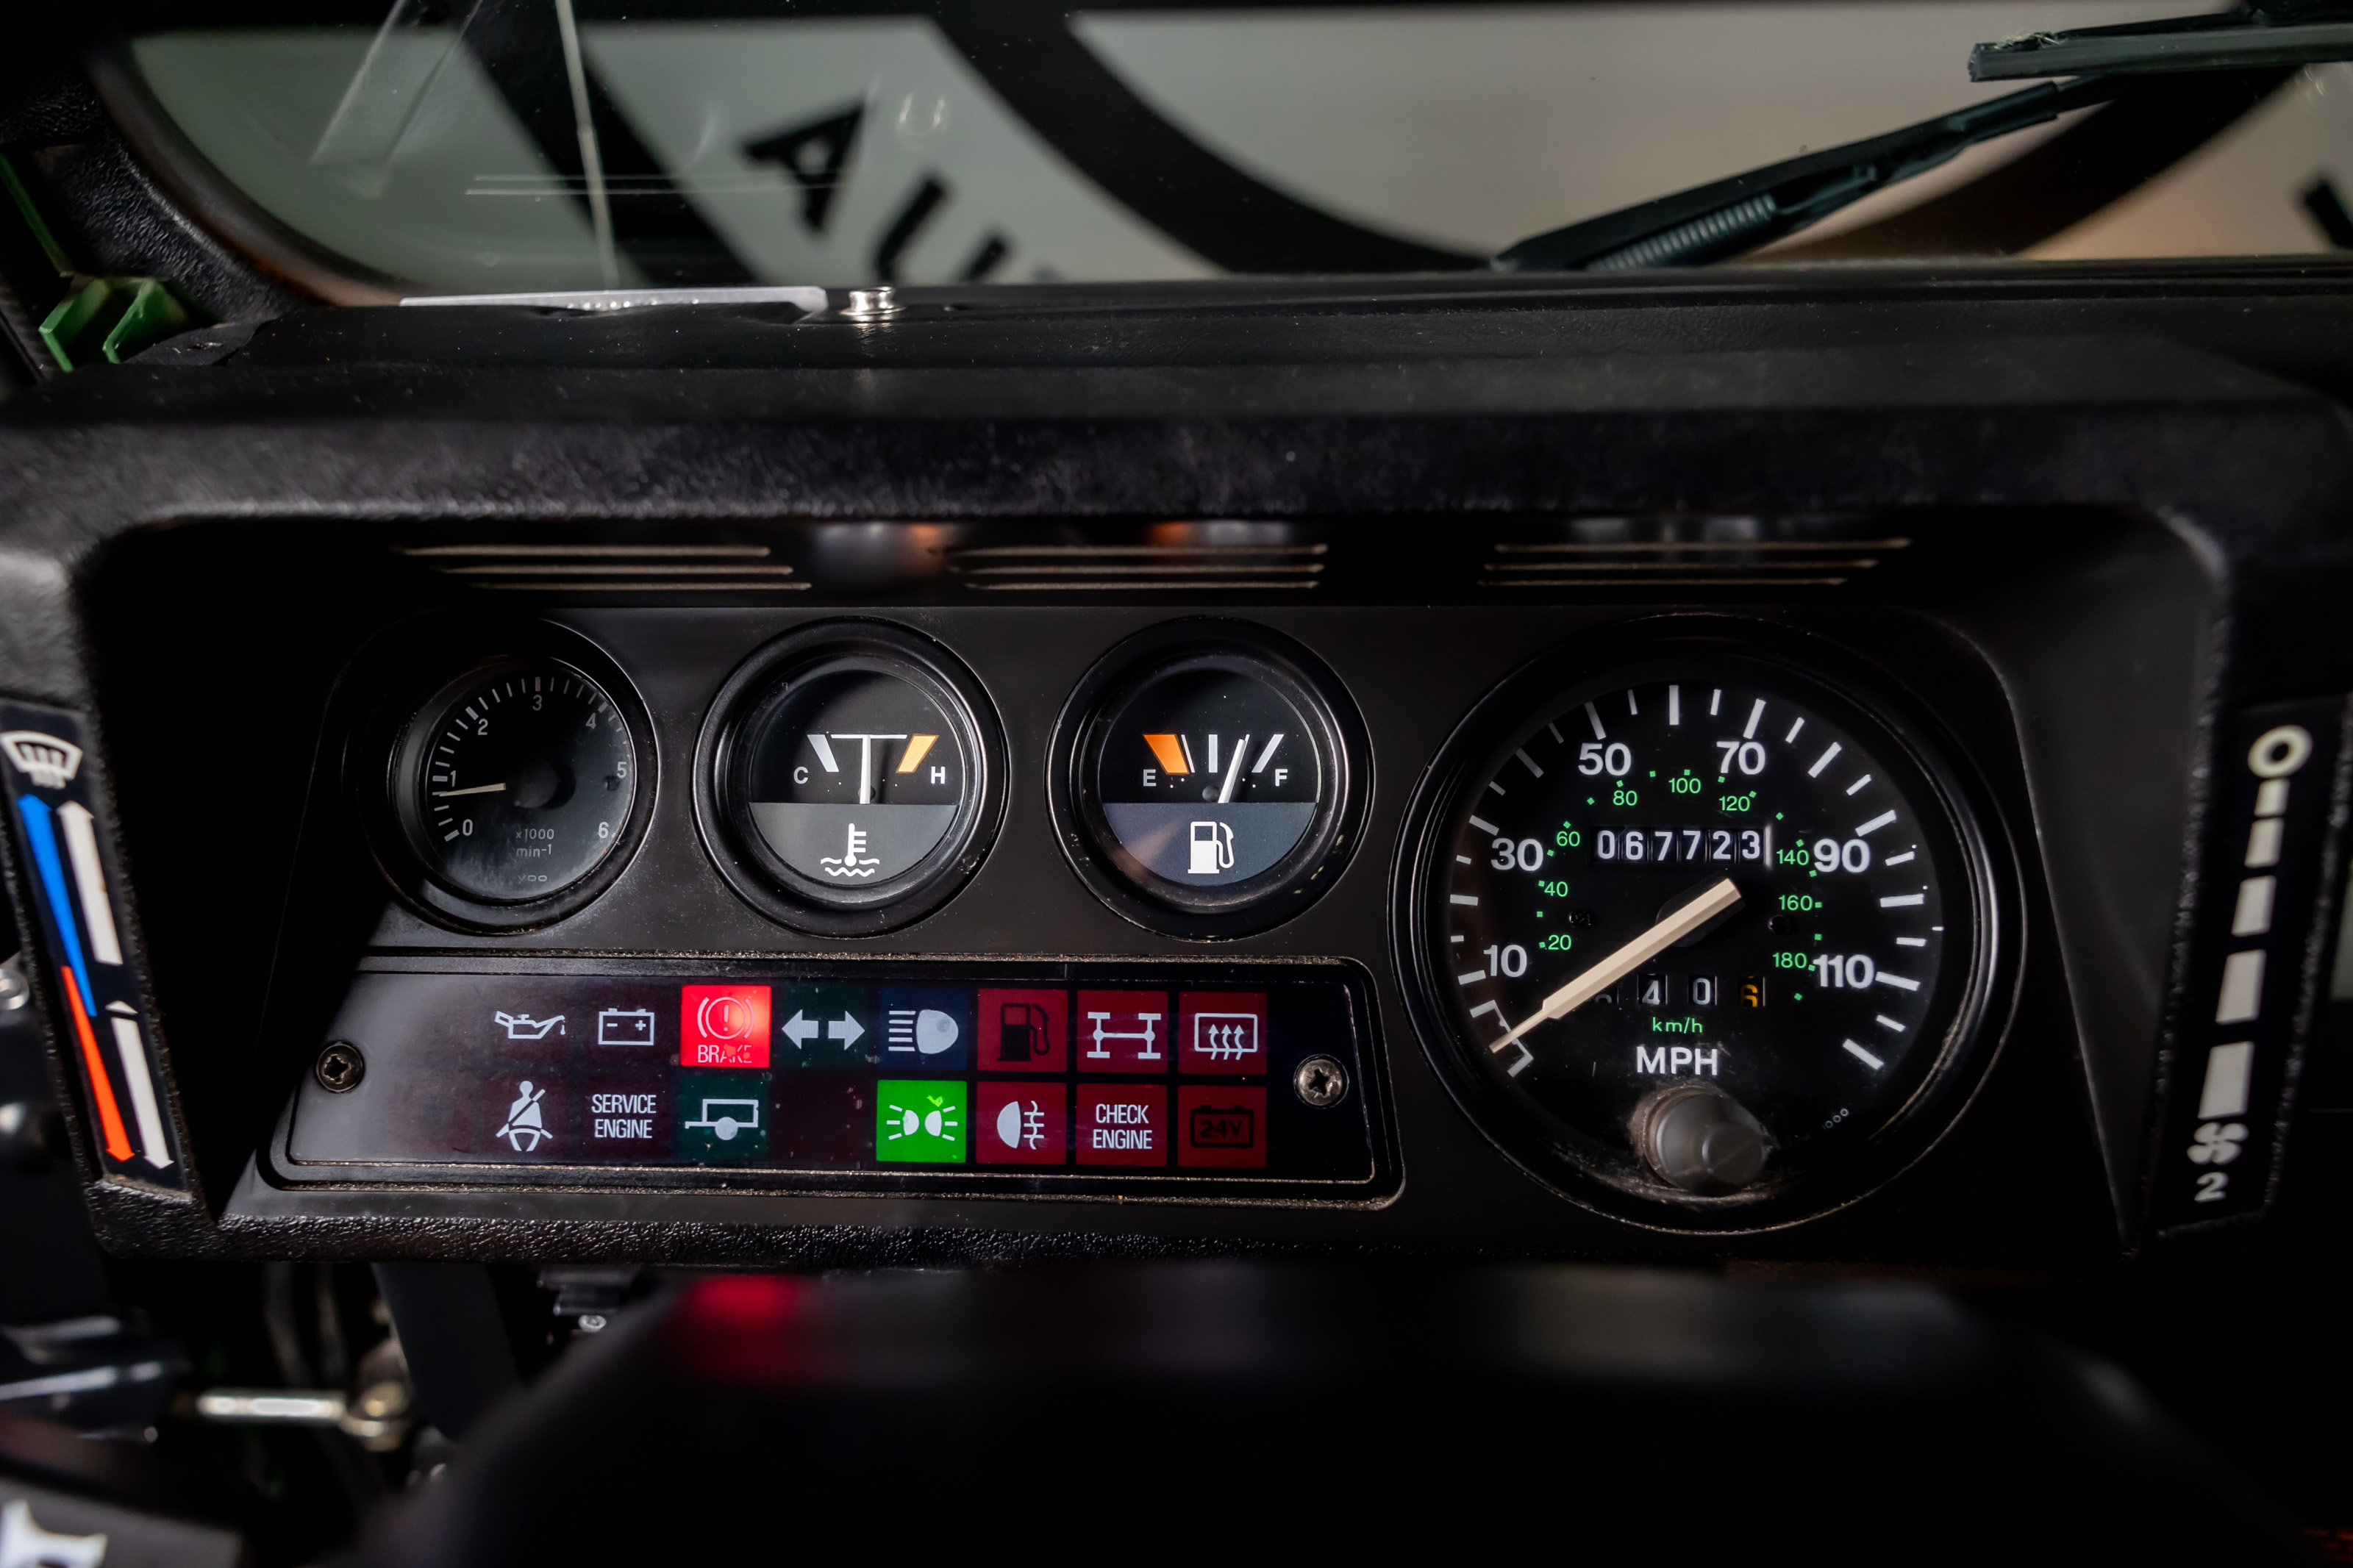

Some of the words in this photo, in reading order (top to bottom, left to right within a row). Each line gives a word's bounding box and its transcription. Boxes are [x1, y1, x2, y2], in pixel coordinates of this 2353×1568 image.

[532, 695, 543, 712] 3
[477, 719, 488, 735] 2
[585, 713, 596, 729] 4
[1578, 742, 1632, 776] 50
[1716, 742, 1765, 775] 70
[449, 770, 457, 787] 1
[617, 762, 627, 778] 5
[793, 766, 809, 784] C
[930, 766, 946, 784] H
[1143, 769, 1157, 787] E
[1275, 768, 1288, 787] F
[1668, 778, 1702, 794] 100
[1613, 790, 1638, 806] 80
[1718, 795, 1750, 812] 120
[462, 819, 474, 837] 0
[598, 821, 610, 839] 6
[1556, 831, 1581, 847] 60
[1597, 830, 1760, 862] 067723
[1490, 838, 1544, 872] 30
[1776, 849, 1809, 866] 140
[1813, 839, 1871, 873] 90
[1544, 881, 1568, 897] 40
[1778, 895, 1813, 912] 160
[1548, 934, 1572, 951] 20
[1483, 944, 1528, 978] 10
[1772, 952, 1807, 969] 180
[1813, 954, 1874, 989] 110
[1652, 1017, 1704, 1034] km/h
[1636, 1046, 1718, 1076] MPH
[591, 1094, 657, 1114] SERVICE
[1096, 1103, 1149, 1125] CHECK
[594, 1119, 653, 1139] ENGINE
[1199, 1119, 1243, 1138] 24V
[1093, 1129, 1153, 1150] ENGINE
[2194, 1171, 2229, 1203] 2
